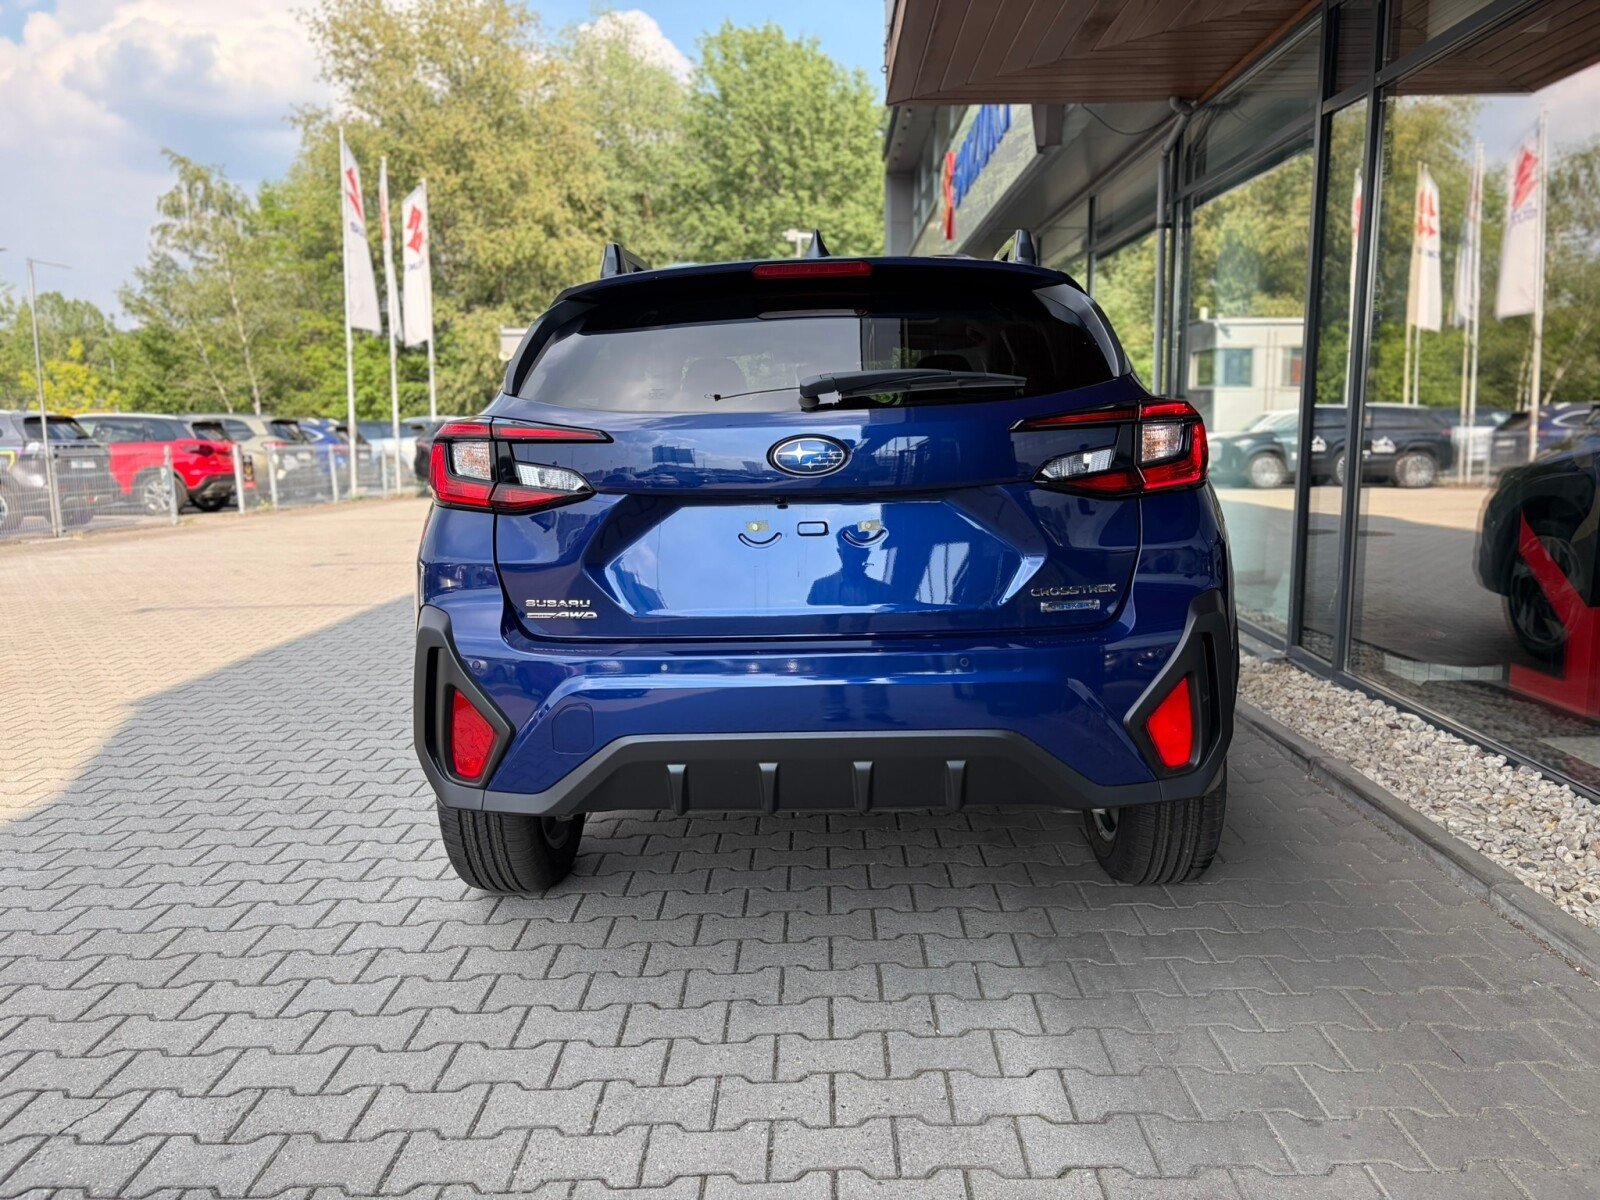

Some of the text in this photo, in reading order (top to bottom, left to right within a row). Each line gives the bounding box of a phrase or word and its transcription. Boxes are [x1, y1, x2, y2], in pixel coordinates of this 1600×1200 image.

[1030, 583, 1117, 597] CROSSTREK
[525, 599, 591, 608] SUBARU
[553, 611, 598, 619] AWD
